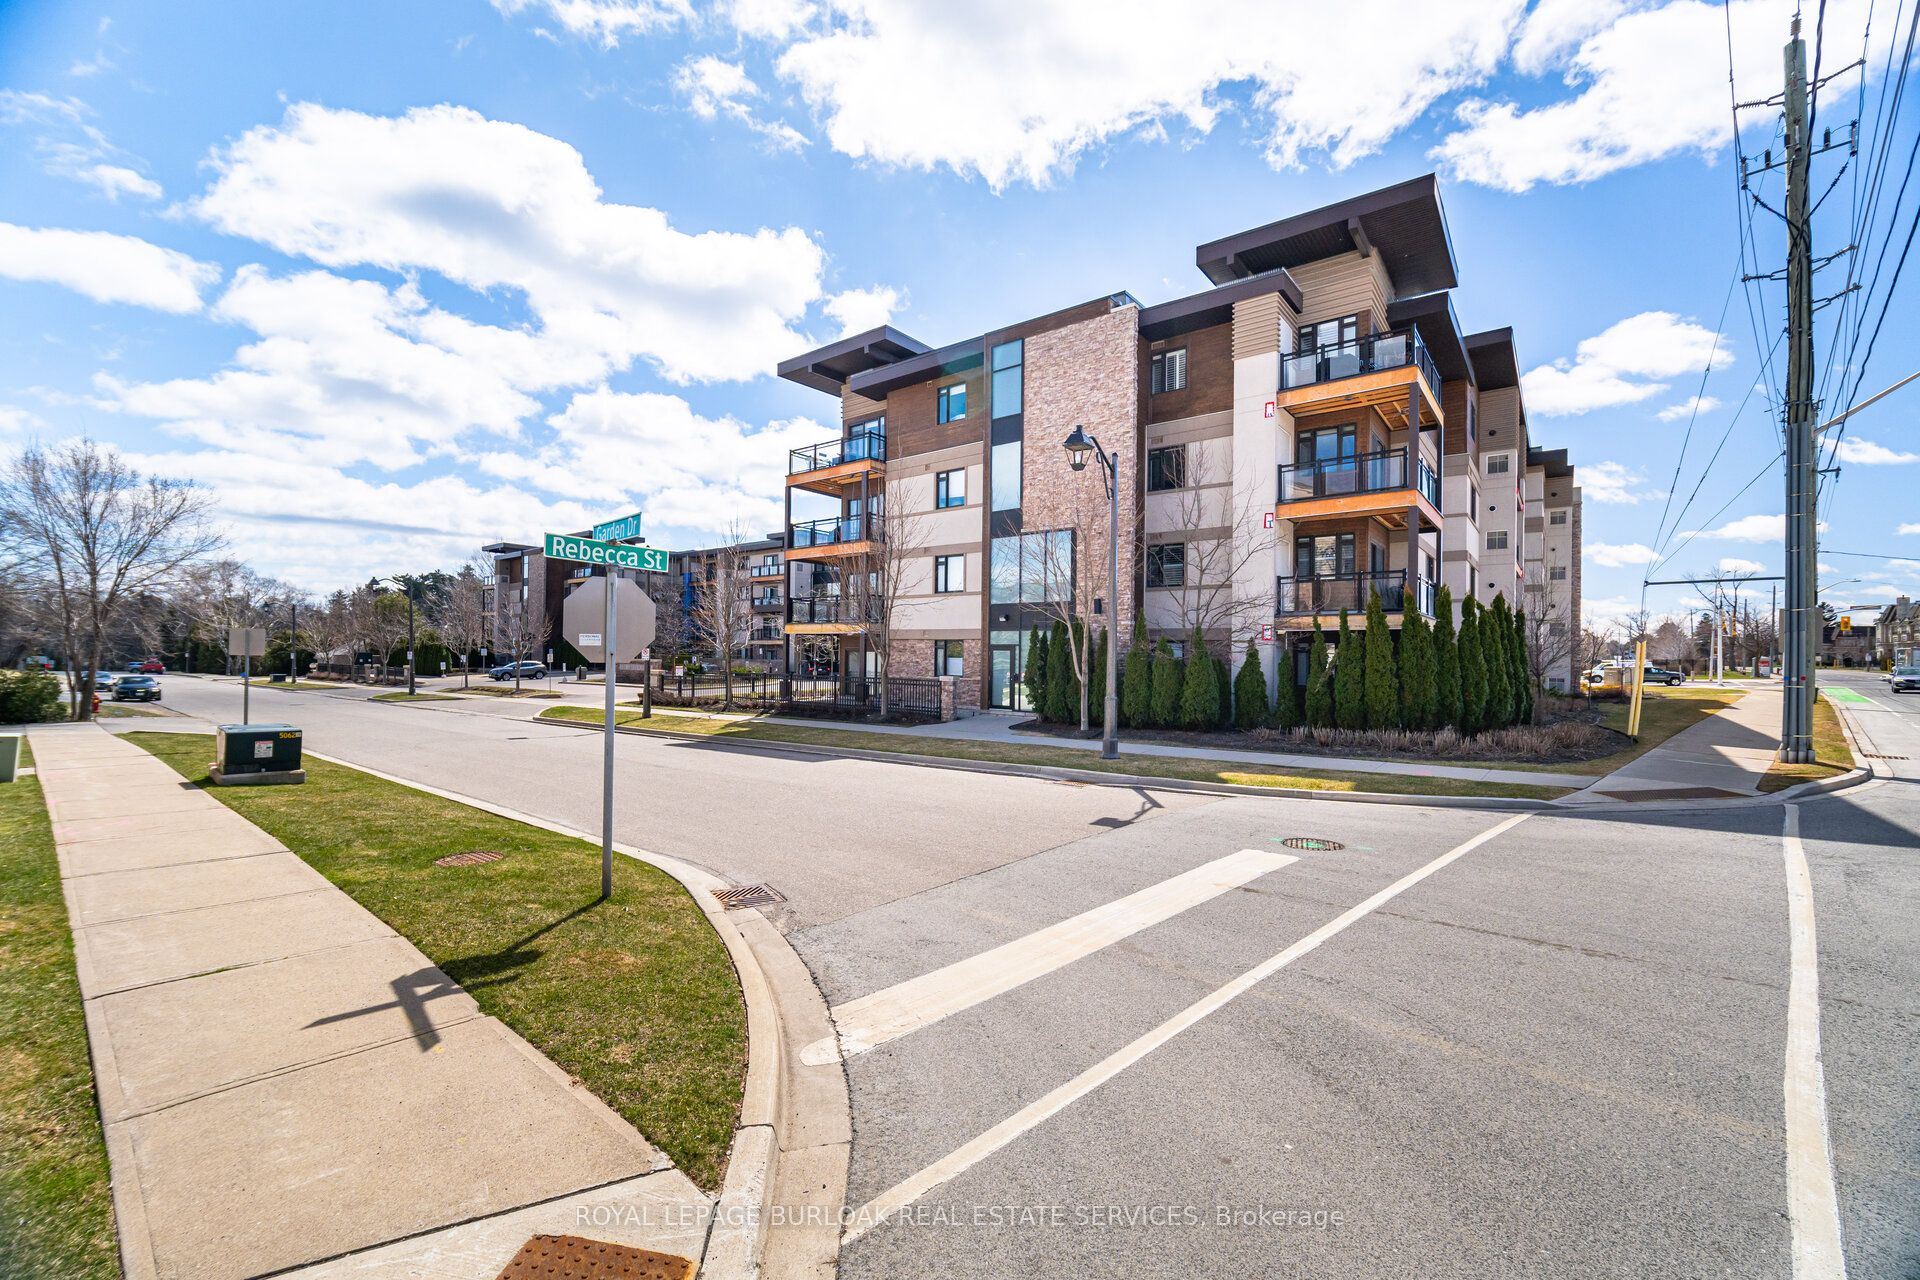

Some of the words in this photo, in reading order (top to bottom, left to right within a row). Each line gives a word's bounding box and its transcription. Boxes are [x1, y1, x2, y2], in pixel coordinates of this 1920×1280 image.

[596, 522, 625, 541] Garden
[627, 517, 637, 536] Dr
[552, 536, 638, 566] Rebecca
[643, 550, 662, 569] St
[279, 731, 296, 739] 5062
